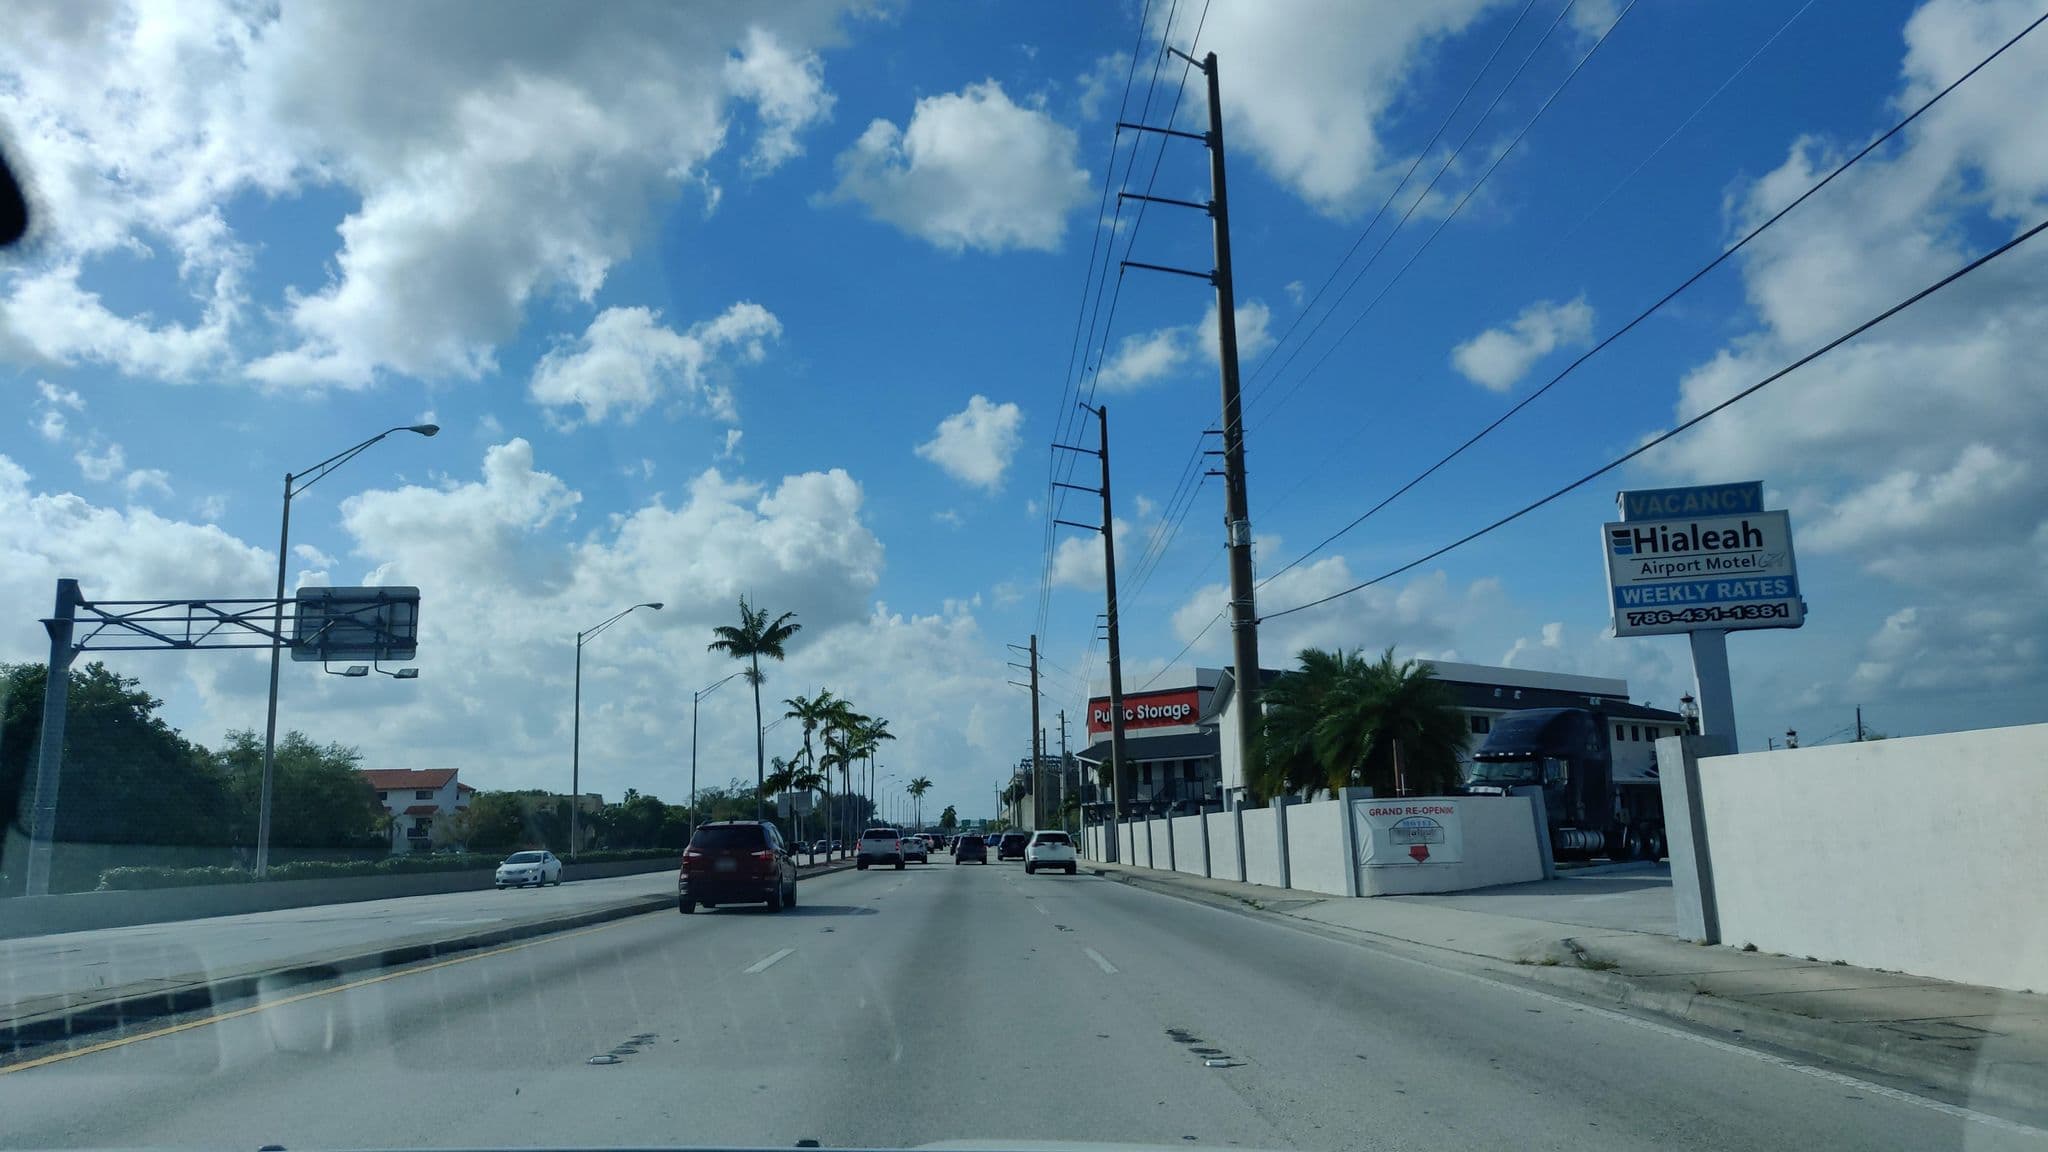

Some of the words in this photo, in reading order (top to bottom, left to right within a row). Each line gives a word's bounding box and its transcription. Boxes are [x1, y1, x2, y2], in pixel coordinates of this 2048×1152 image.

[1630, 488, 1755, 514] VACANCY
[1633, 521, 1763, 553] Hialeah
[1641, 557, 1701, 576] Airport
[1706, 554, 1757, 571] Motel
[1622, 584, 1709, 603] WEEKLY
[1717, 579, 1788, 598] RATES
[1627, 604, 1789, 626] 786-431-1381
[1094, 708, 1133, 723] Puic
[1137, 703, 1190, 720] Storage
[1369, 807, 1403, 816] GRAND
